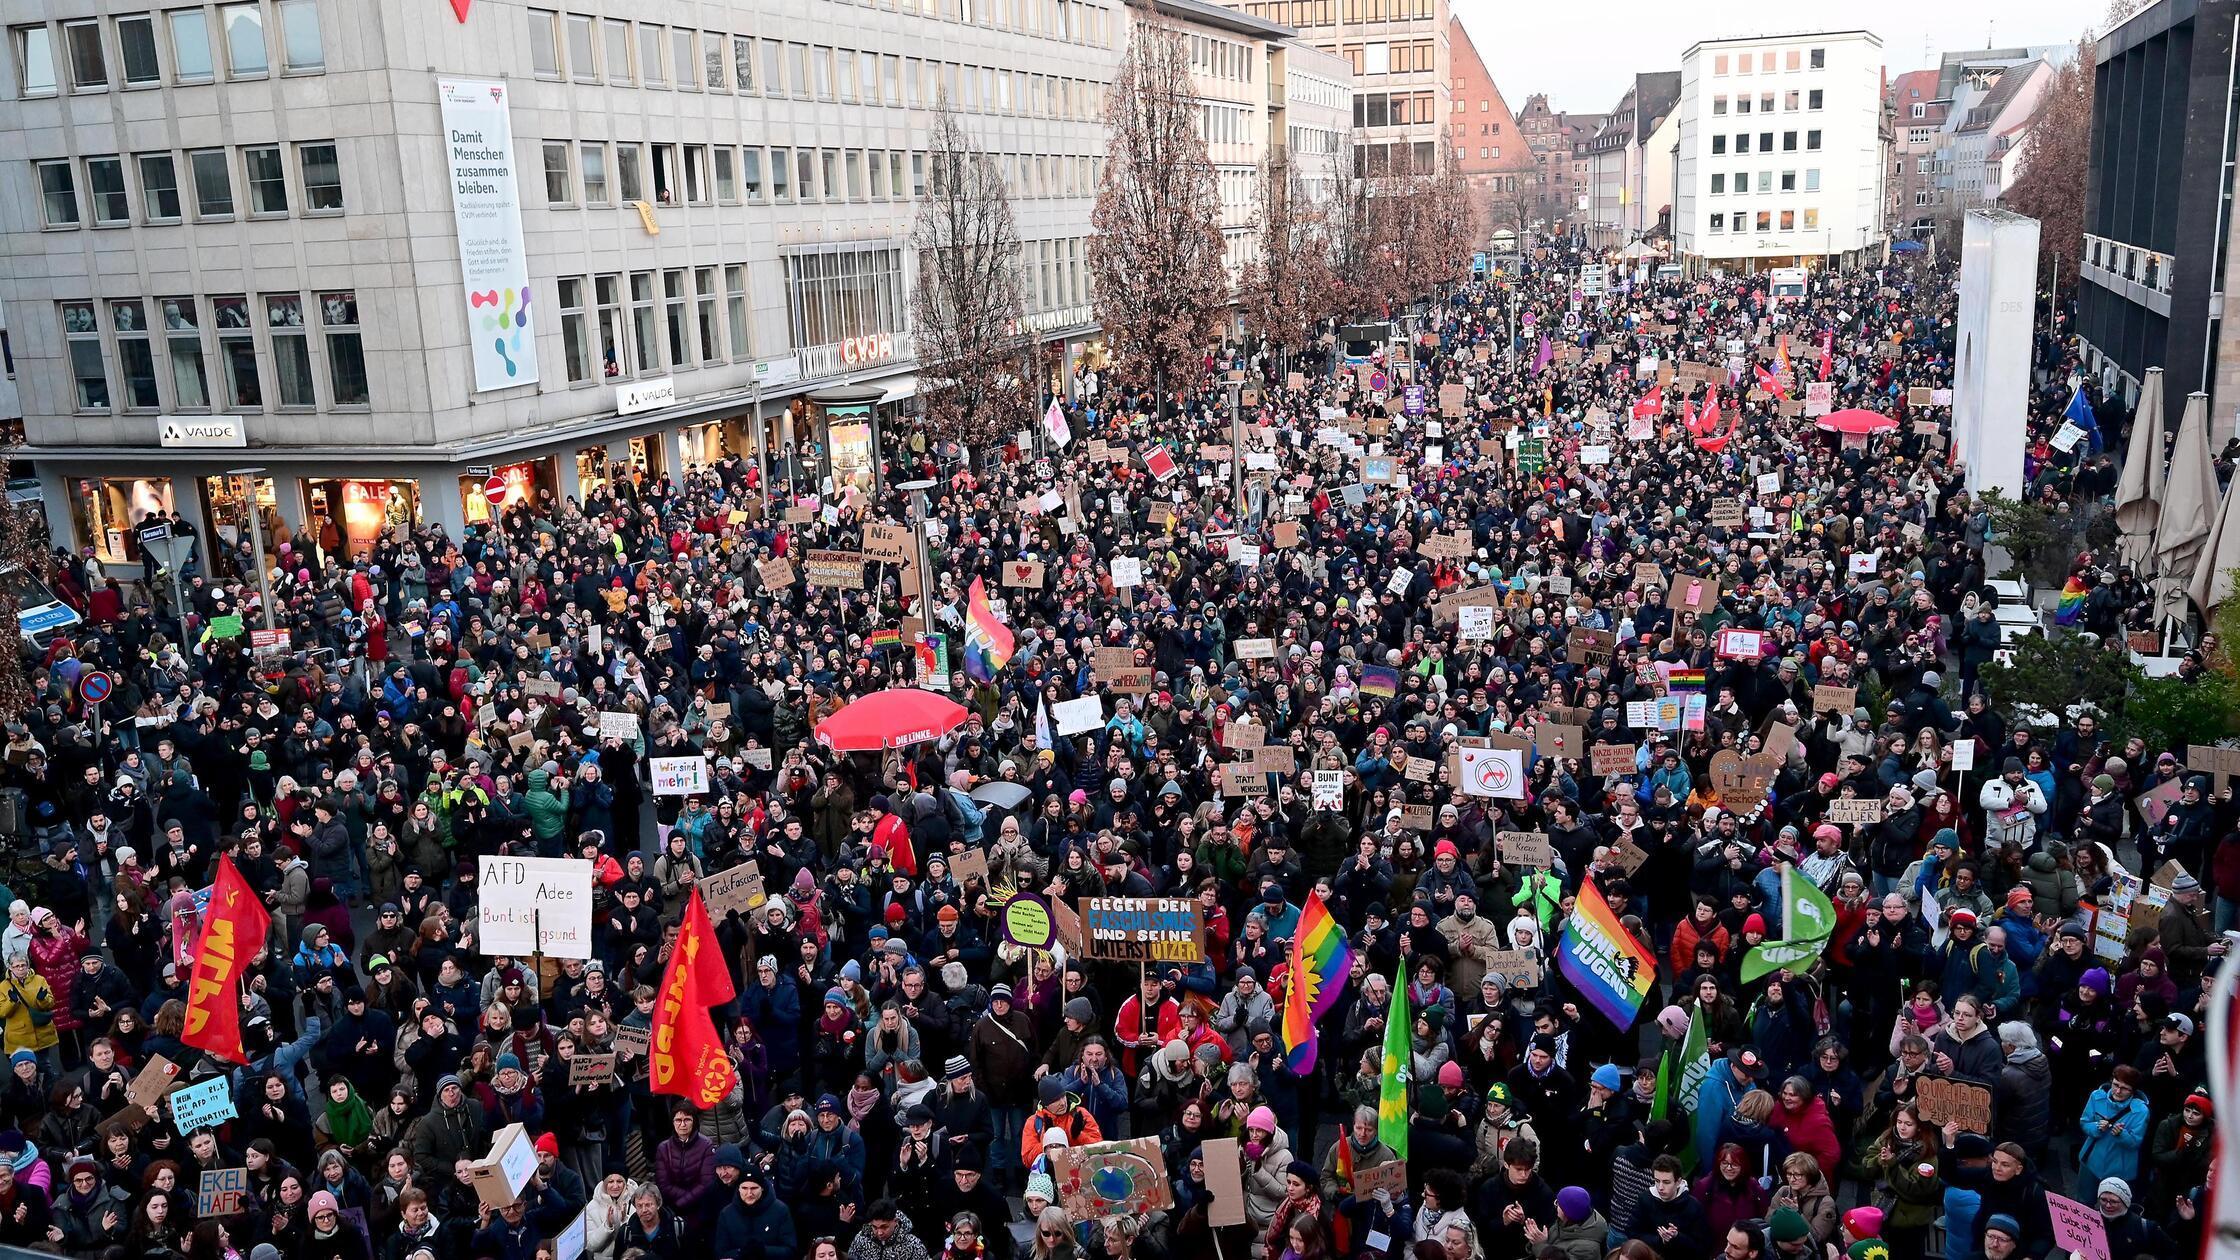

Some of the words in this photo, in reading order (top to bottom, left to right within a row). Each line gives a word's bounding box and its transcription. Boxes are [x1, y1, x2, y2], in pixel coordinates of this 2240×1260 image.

[452, 130, 483, 144] Damit
[453, 146, 505, 161] Menschen
[456, 166, 509, 177] zusammen
[458, 181, 498, 194] bleiben.
[2000, 301, 2023, 313] DES
[1016, 306, 1093, 336] BUCHHANDLUNG
[842, 333, 892, 365] CVJM
[641, 386, 673, 402] VAUDE
[185, 427, 233, 437] VAUDE
[502, 467, 529, 484] SALE
[350, 485, 386, 500] SALE
[871, 527, 893, 540] Nie
[28, 611, 65, 625] POLIZEI
[1815, 687, 1850, 699] ZUKUNFT
[1815, 702, 1851, 713] GEMEINSAM
[895, 735, 908, 745] DIE
[909, 729, 934, 742] LINKE.
[1592, 748, 1612, 757] NAZIS
[1613, 748, 1634, 757] HATTEN
[659, 761, 678, 771] Wir
[679, 761, 697, 771] sind
[1599, 757, 1611, 765] WIR
[1611, 756, 1630, 765] SCHON
[658, 772, 699, 790] mehr!
[1235, 775, 1255, 784] STATT
[1317, 772, 1338, 783] BUNT
[1240, 784, 1267, 793] MENSCHEN
[1833, 800, 1880, 811] GLITZER
[1831, 811, 1876, 822] MAUER
[1503, 833, 1523, 843] Mach
[1524, 833, 1542, 843] Dein
[1515, 842, 1537, 853] Kreuz
[1504, 853, 1521, 861] ohne
[1522, 854, 1544, 864] Haken
[484, 862, 525, 886] AFD
[536, 882, 573, 901] Adee
[709, 877, 731, 899] Fuck
[730, 871, 759, 890] Fascism
[1090, 897, 1147, 912] GEGEN
[1158, 899, 1191, 913] DEN
[483, 907, 514, 924] Bunt
[519, 907, 535, 923] ist
[1088, 909, 1197, 931] FASCHISMUS
[540, 926, 577, 945] gsund
[1093, 928, 1126, 941] UND
[1136, 929, 1192, 942] SEINE
[1090, 939, 1198, 960] UNTERSTÜTZER
[1571, 941, 1629, 1001] JUGEND
[572, 1073, 612, 1082] Wunderland
[1930, 1081, 1962, 1101] UNRECHT
[1970, 1088, 1990, 1107] RECHT
[177, 1104, 188, 1112] DIE
[192, 1099, 206, 1110] AFD
[1954, 1101, 1990, 1123] WIDERSTAND
[177, 1110, 194, 1121] KEINE
[182, 1108, 230, 1130] ALTERNATIVE
[1930, 1110, 1950, 1123] ZUR
[202, 1170, 245, 1193] EKEL
[1364, 1166, 1395, 1184] BUNT
[200, 1192, 242, 1214] HAFD
[2049, 1198, 2067, 1212] Hass
[2069, 1203, 2081, 1216] ist
[2059, 1212, 2080, 1229] Liebe
[2079, 1223, 2093, 1234] ist
[2066, 1225, 2092, 1248] slay!
